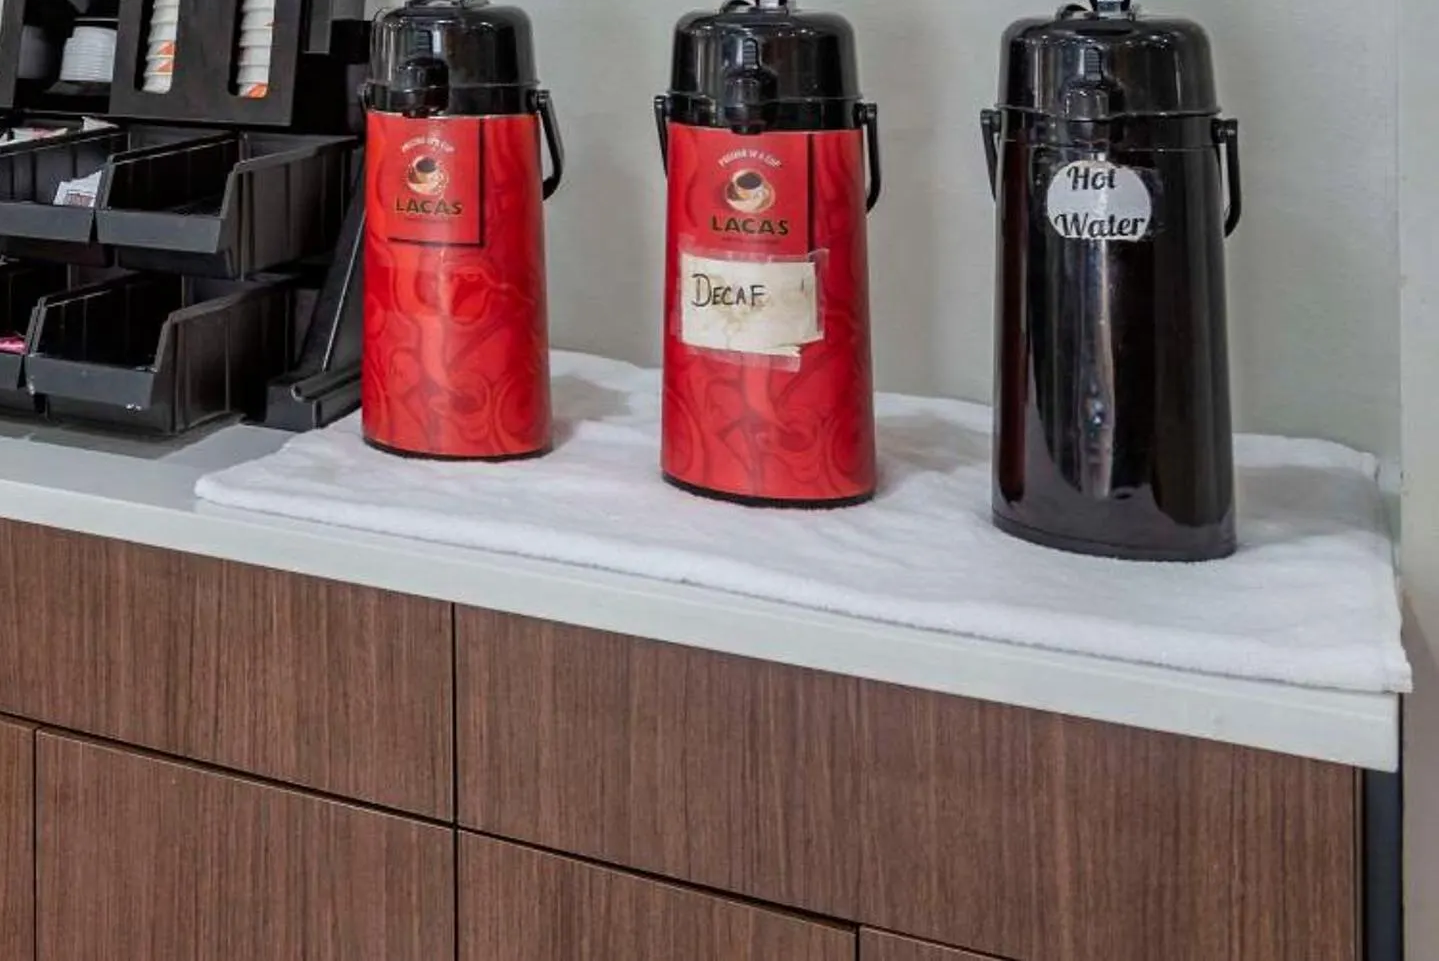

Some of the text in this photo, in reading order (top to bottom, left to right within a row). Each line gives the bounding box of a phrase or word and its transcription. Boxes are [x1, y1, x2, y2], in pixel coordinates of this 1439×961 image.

[1066, 165, 1117, 191] Hot
[396, 197, 463, 216] LACAS
[711, 215, 789, 236] LACAS
[1054, 212, 1146, 238] Water
